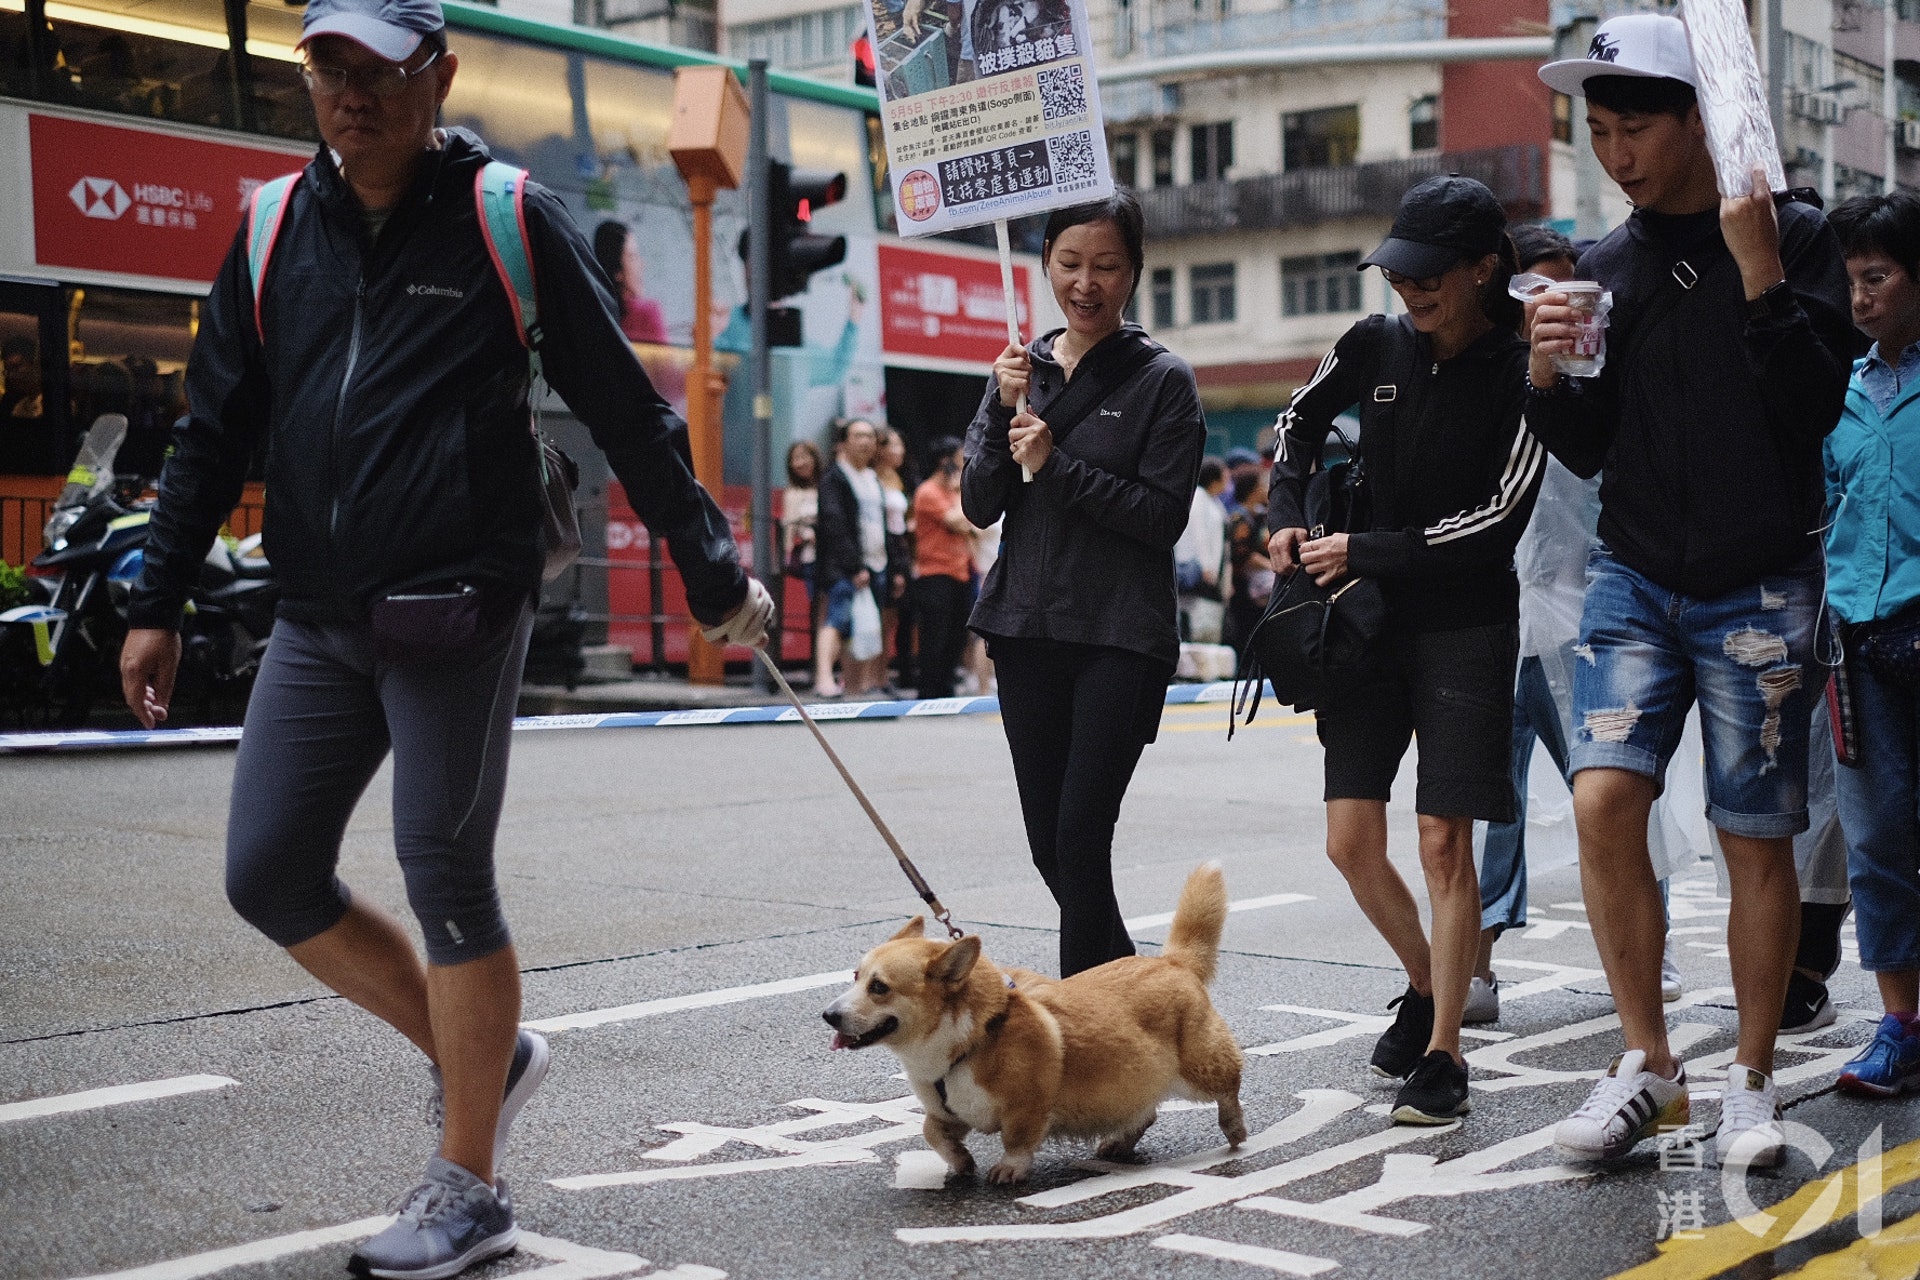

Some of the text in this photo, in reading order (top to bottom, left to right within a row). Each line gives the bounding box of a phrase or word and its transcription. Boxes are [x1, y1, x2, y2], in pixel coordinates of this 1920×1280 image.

[978, 34, 1078, 76] 被撲殺貓隻
[890, 101, 923, 119] 5月5日
[929, 91, 973, 112] 下午2:30
[892, 115, 929, 133] 集合地點
[986, 134, 998, 144] QR
[999, 130, 1017, 141] Code
[945, 149, 1019, 181] 請讚好專頁
[134, 182, 184, 207] HSBC
[946, 166, 1050, 204] 支持零虐畜運動
[948, 188, 1052, 217] fb.com/ZeroAnimalAbuse
[417, 284, 464, 298] Columbia
